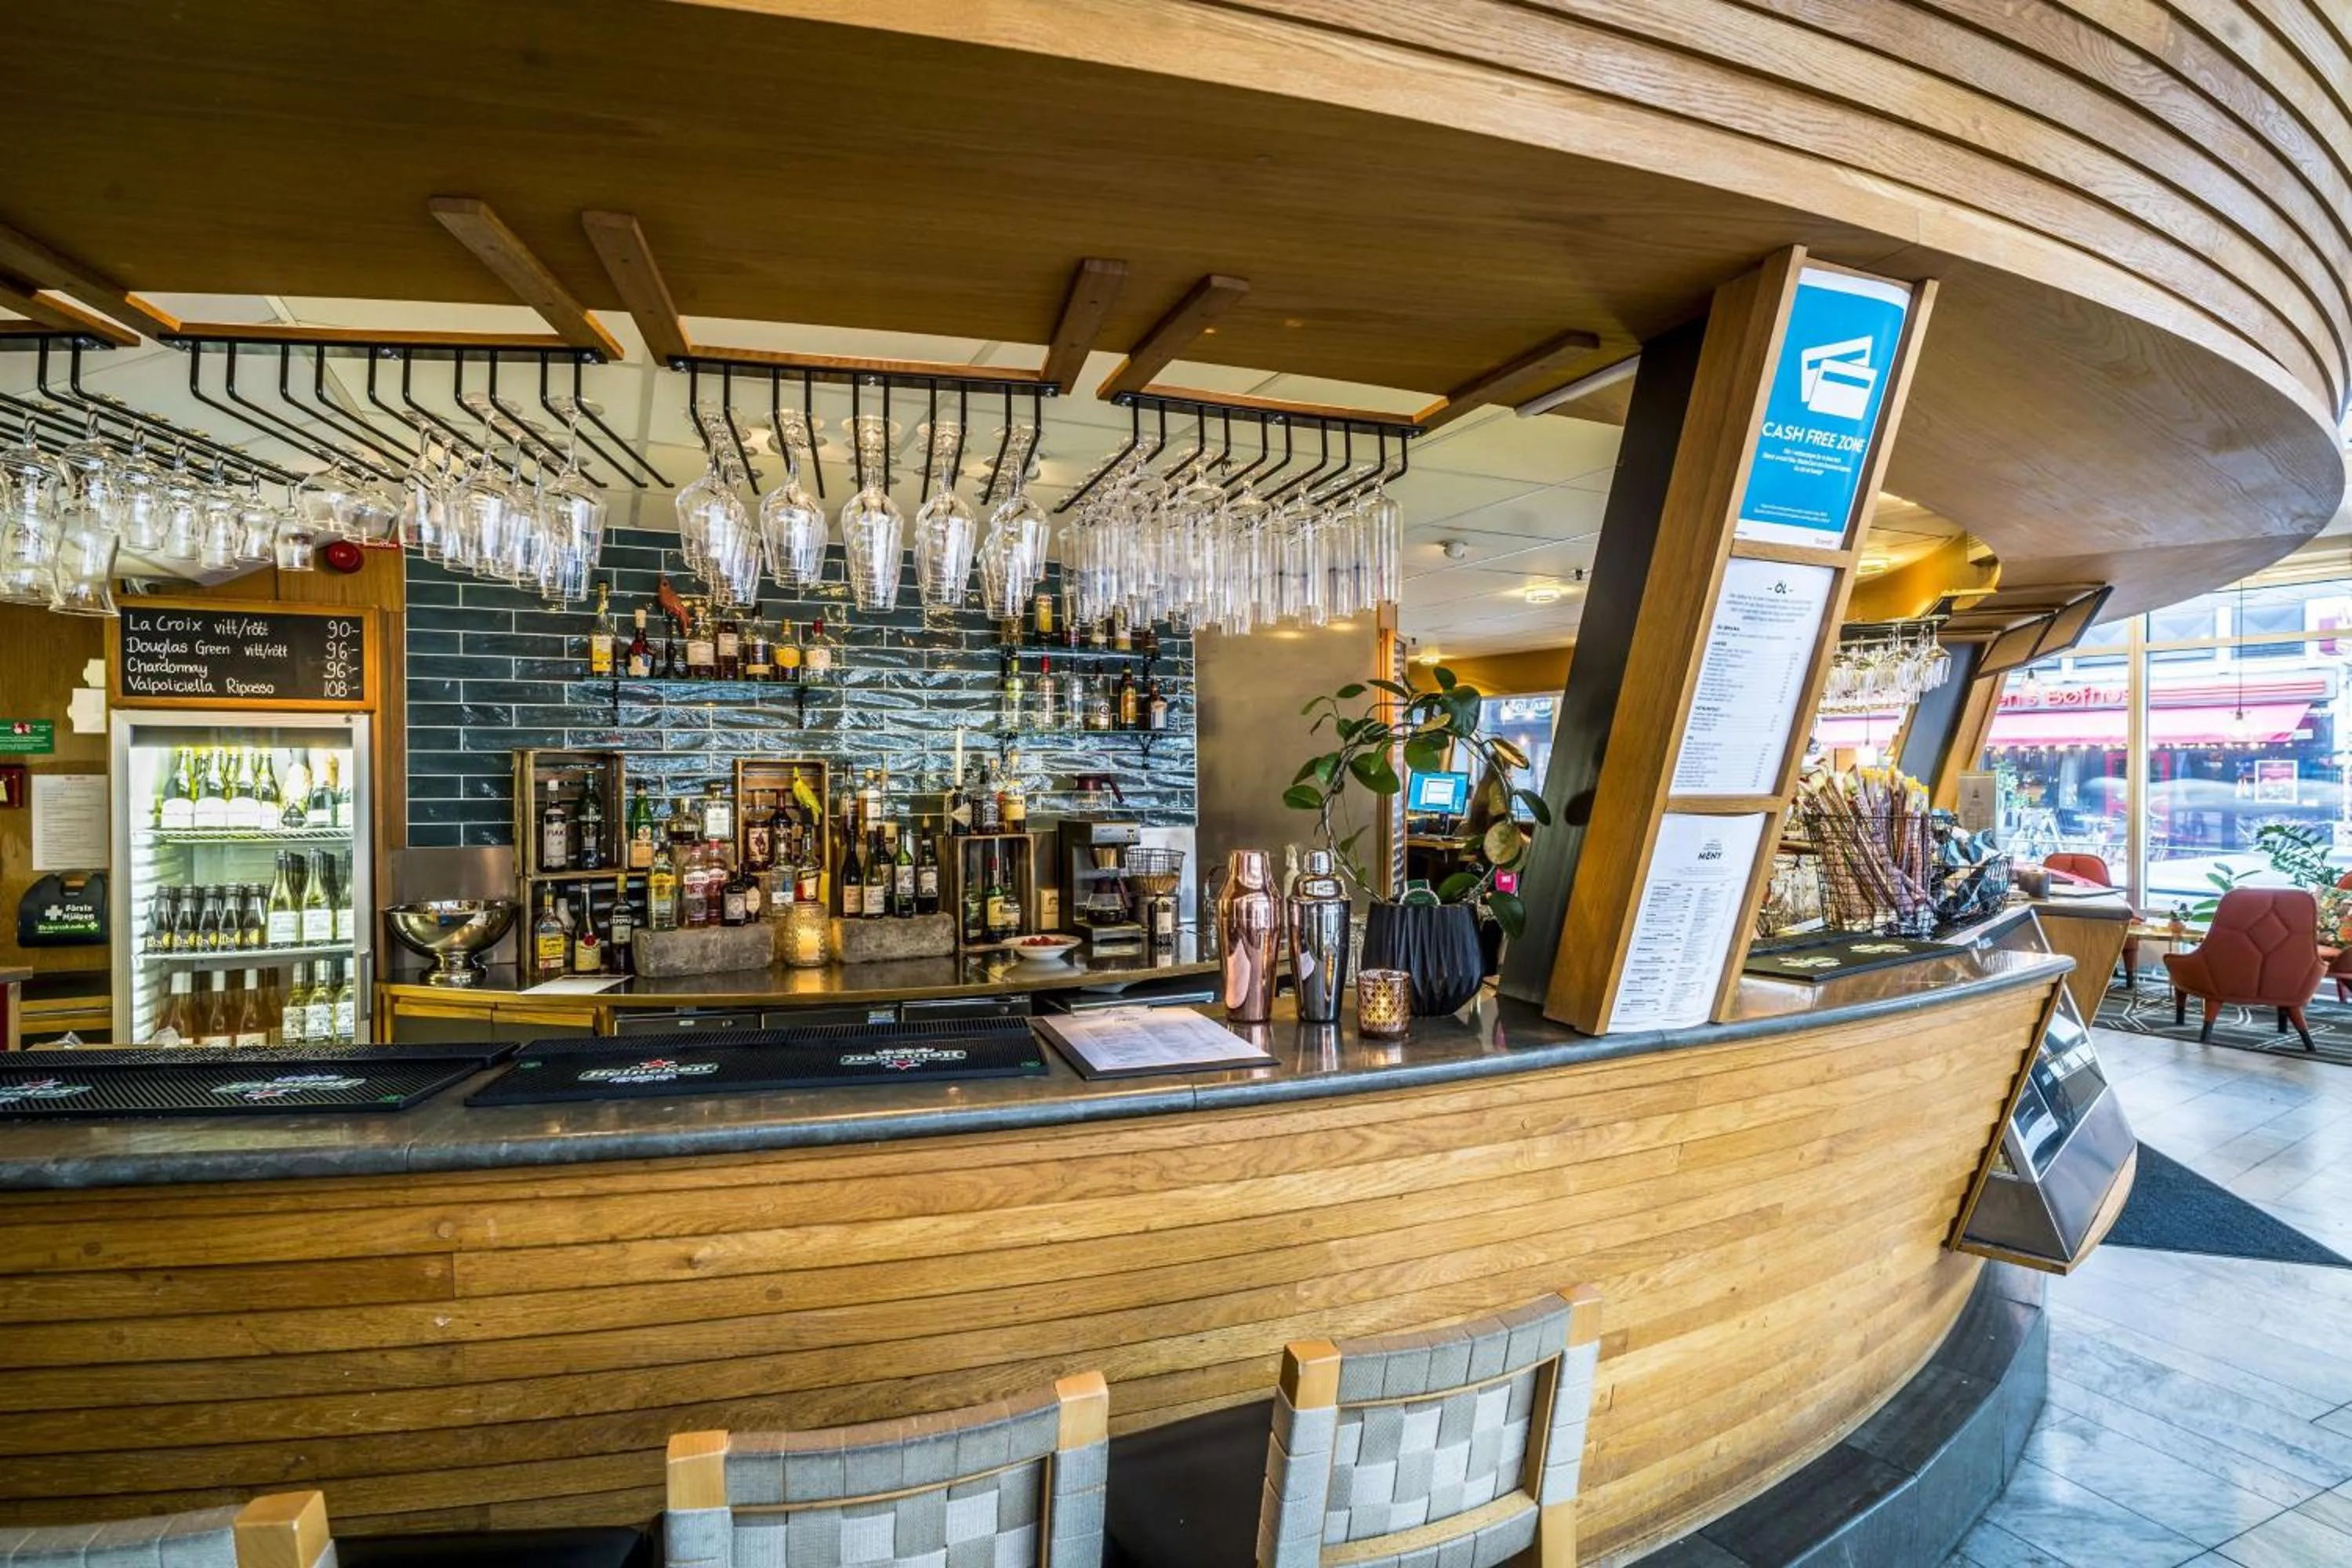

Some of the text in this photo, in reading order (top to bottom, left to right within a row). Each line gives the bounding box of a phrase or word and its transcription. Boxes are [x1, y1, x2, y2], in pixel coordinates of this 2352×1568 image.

[1762, 422, 1866, 453] CASH FREE ZONE
[129, 614, 151, 631] La
[156, 615, 203, 631] Croix
[126, 636, 188, 659] Douglas
[195, 639, 231, 656] Green
[127, 656, 208, 678] Chardonnay
[226, 677, 274, 696] Ripasso
